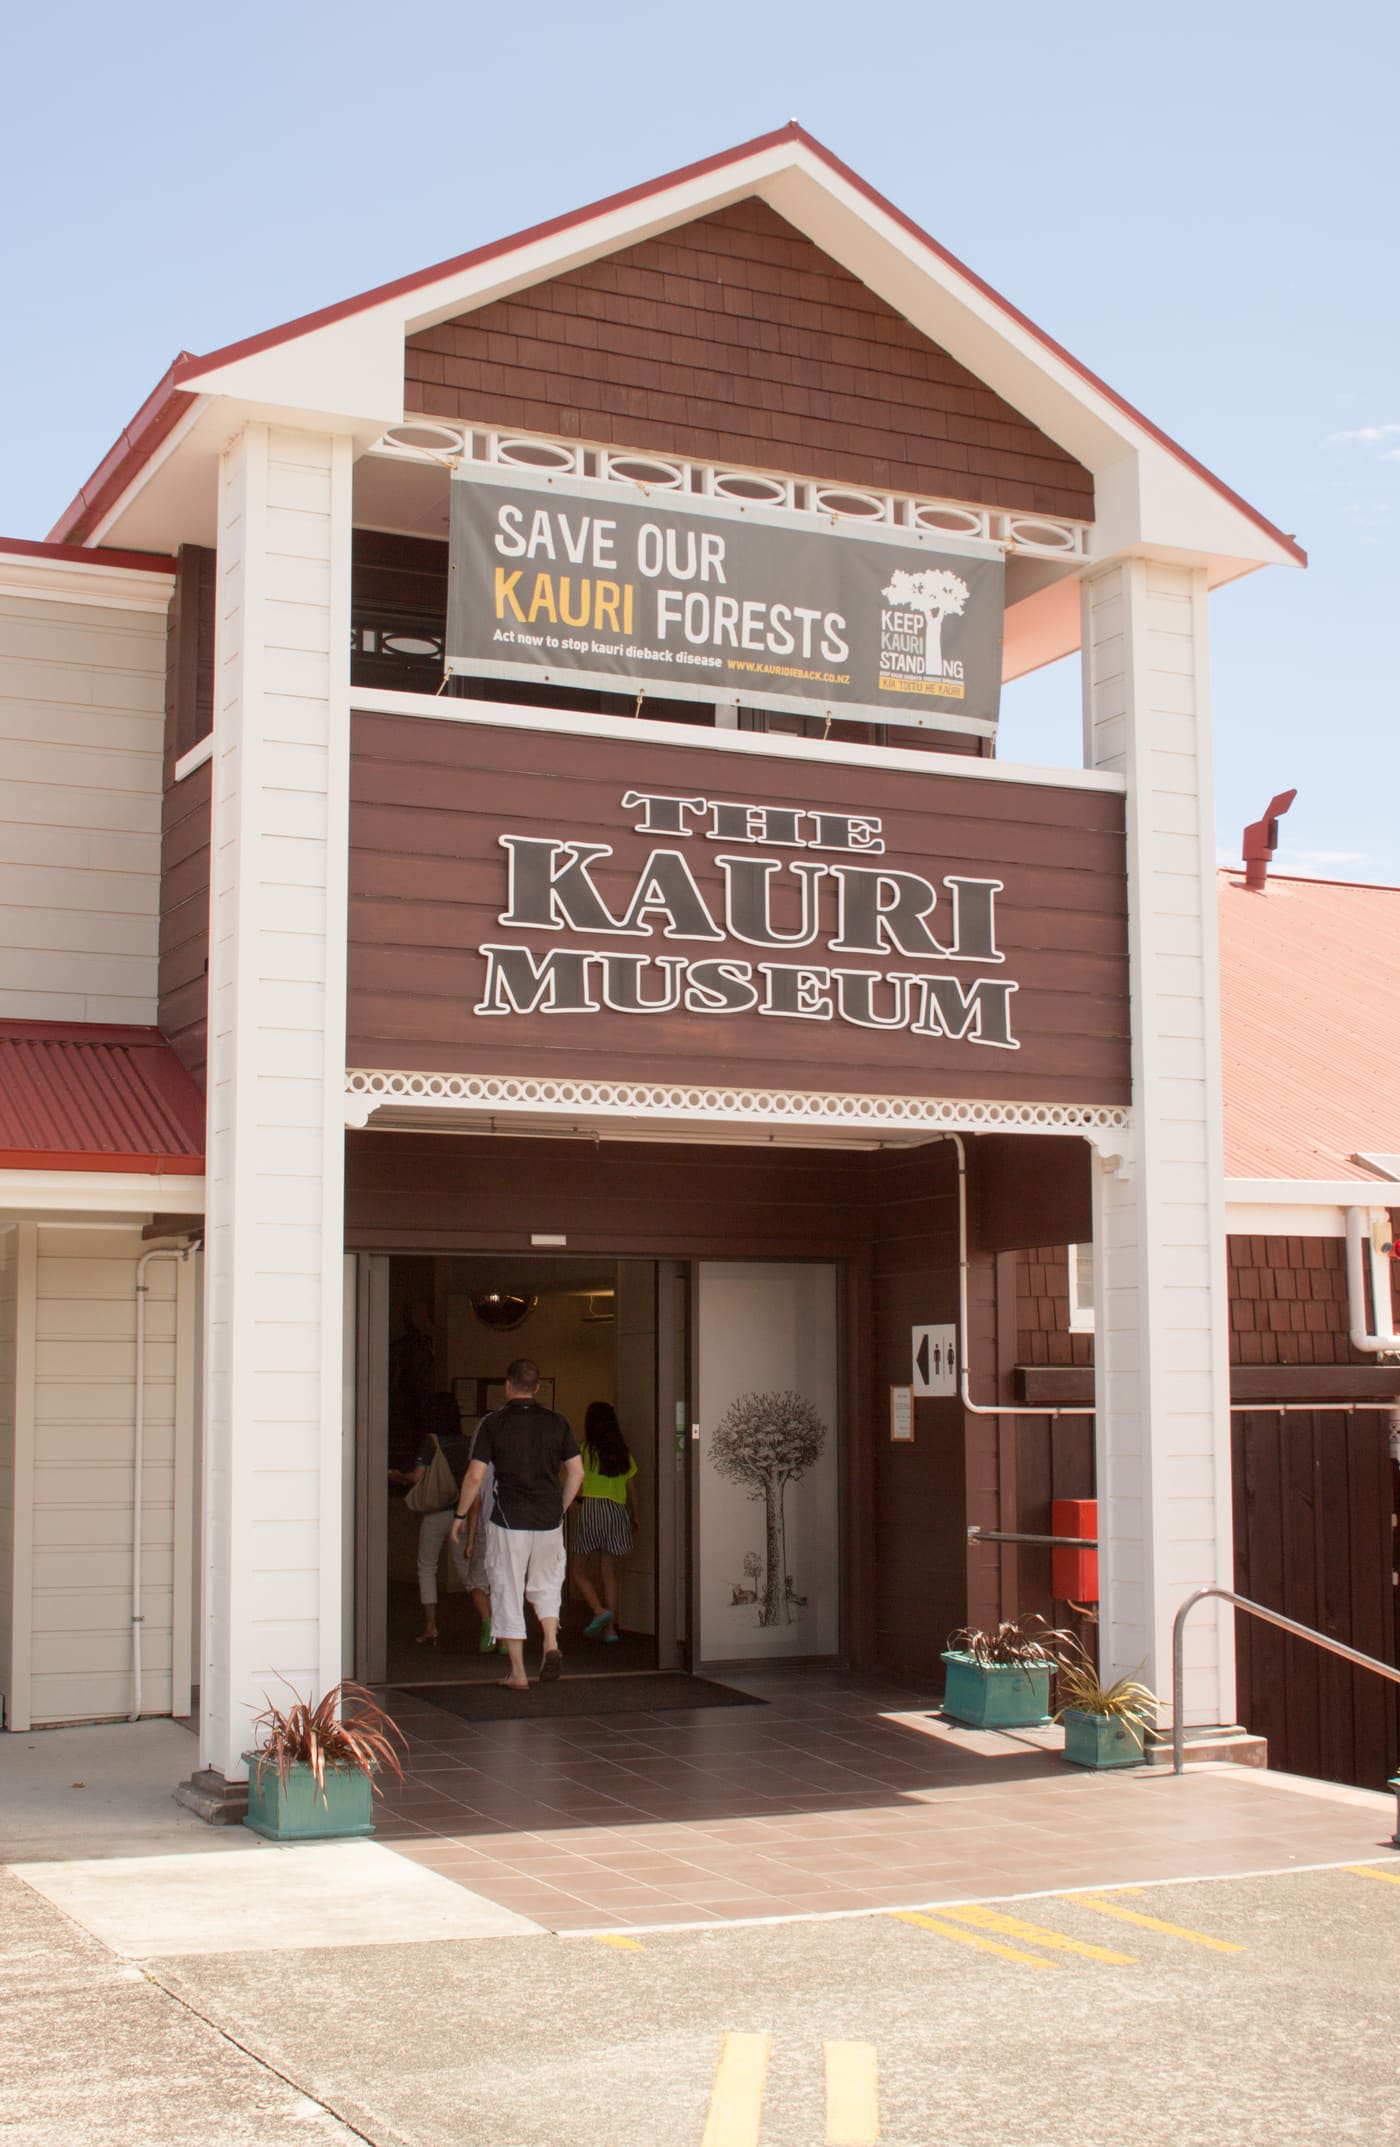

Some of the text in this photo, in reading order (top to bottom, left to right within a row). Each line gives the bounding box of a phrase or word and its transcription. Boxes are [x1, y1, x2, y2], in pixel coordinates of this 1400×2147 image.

[494, 504, 727, 584] SAVE OUR
[493, 628, 723, 668] Act now to stop kauri dieback disease
[494, 567, 849, 663] KAURI FORESTS
[881, 608, 924, 635] KEEP
[881, 631, 924, 655] KAURI
[727, 659, 851, 684] WWW.KAURIDIEBACK.CO.NZ
[621, 789, 886, 855] THE
[498, 833, 1006, 964] KAURI
[473, 943, 1022, 1050] MUSEUM
